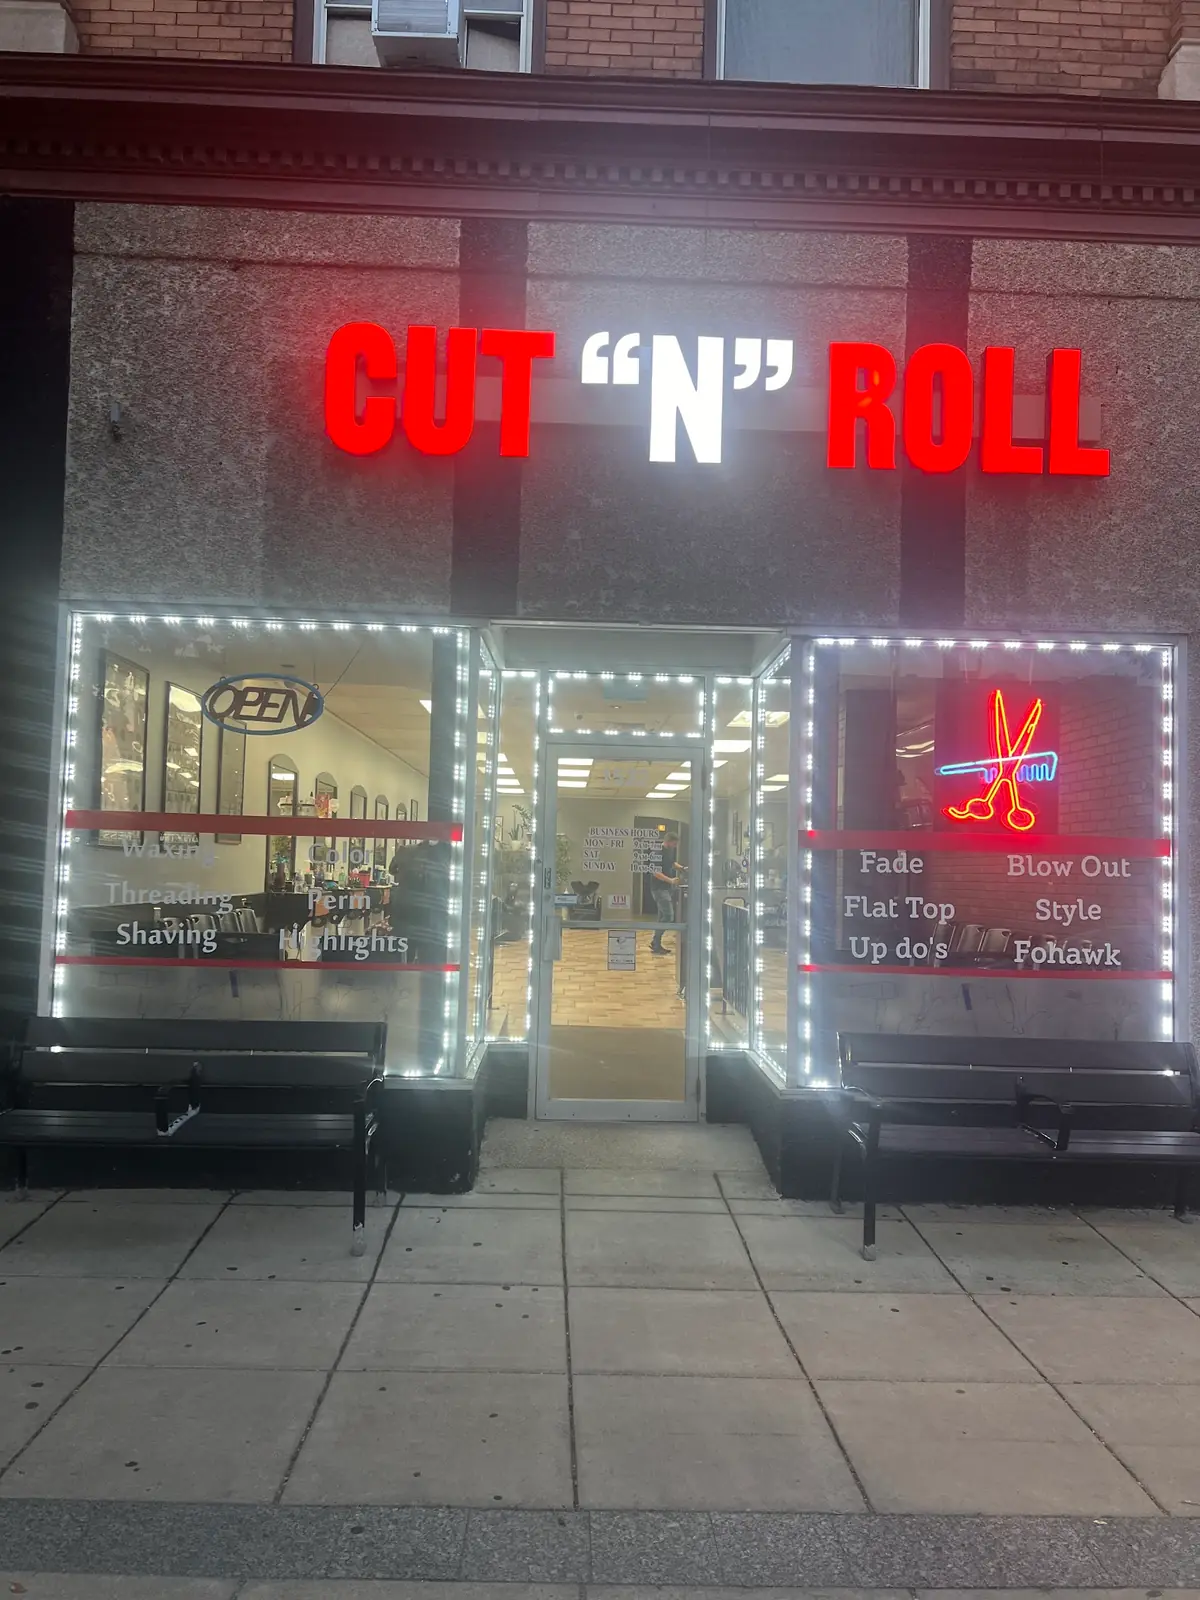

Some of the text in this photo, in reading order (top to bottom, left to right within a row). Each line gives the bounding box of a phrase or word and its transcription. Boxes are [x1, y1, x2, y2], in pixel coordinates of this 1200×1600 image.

[324, 321, 554, 457] CUT
[828, 342, 1110, 476] ROLL
[207, 684, 314, 728] OPEN
[584, 839, 604, 848] MON
[611, 840, 624, 848] FRI
[590, 827, 660, 838] BUSINESS HOURS
[122, 837, 216, 868] Waxing
[307, 841, 375, 864] Color
[584, 850, 600, 859] SAT
[860, 851, 924, 874] Fade
[1007, 854, 1131, 878] Blow Out
[583, 862, 616, 871] SUNDAY
[105, 881, 234, 914] Threading
[308, 886, 372, 911] Perm
[844, 895, 955, 924] Flat Top
[1036, 898, 1102, 926] Style
[116, 920, 218, 954] Shaving
[279, 922, 409, 961] Highlights
[849, 937, 948, 965] Up do's
[1014, 940, 1122, 966] Fohawk
